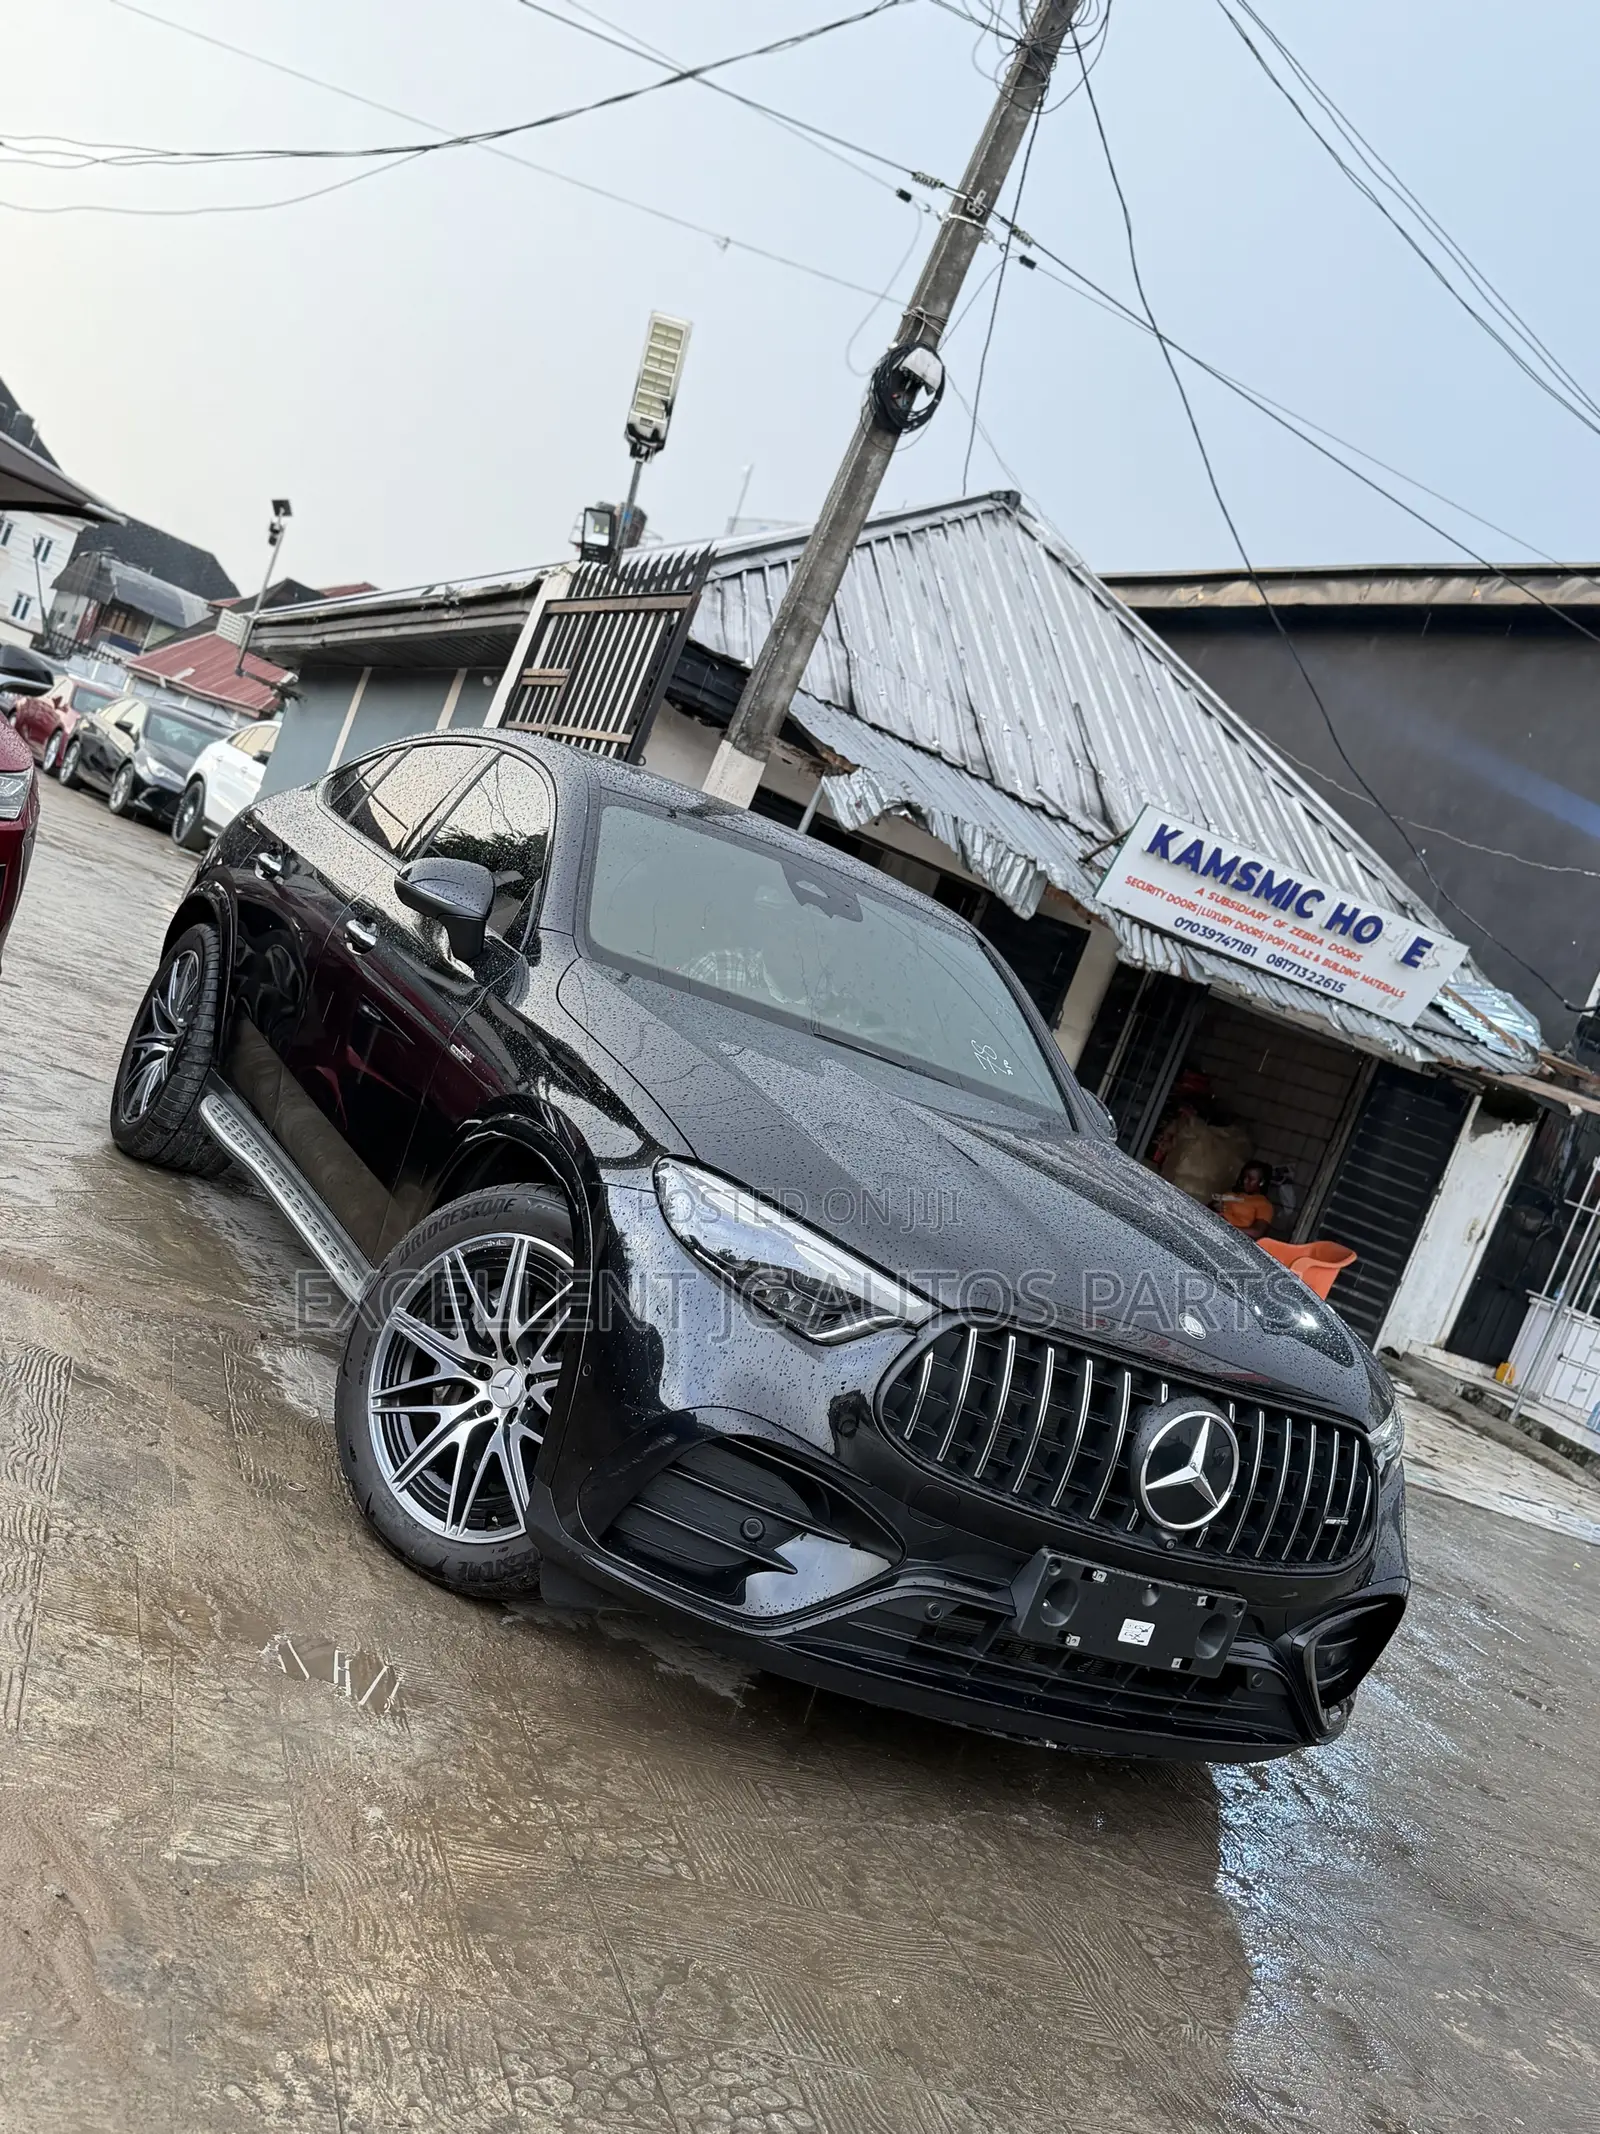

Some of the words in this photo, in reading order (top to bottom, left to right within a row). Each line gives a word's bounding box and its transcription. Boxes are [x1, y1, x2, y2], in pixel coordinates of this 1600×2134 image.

[1147, 824, 1325, 919] KAMSMIC
[1126, 876, 1167, 896] SECURITY
[1313, 954, 1320, 963] &
[1321, 959, 1359, 979] BUILDING
[1362, 976, 1405, 998] MATERIALS
[1174, 918, 1257, 957] 07039747181
[1267, 954, 1346, 992] 08171322615
[1196, 888, 1205, 896] A
[1208, 892, 1269, 920] SUBSIDIARY
[1274, 920, 1287, 928] OF
[1290, 928, 1324, 946] ZEBRA
[1328, 944, 1362, 961] DOORS
